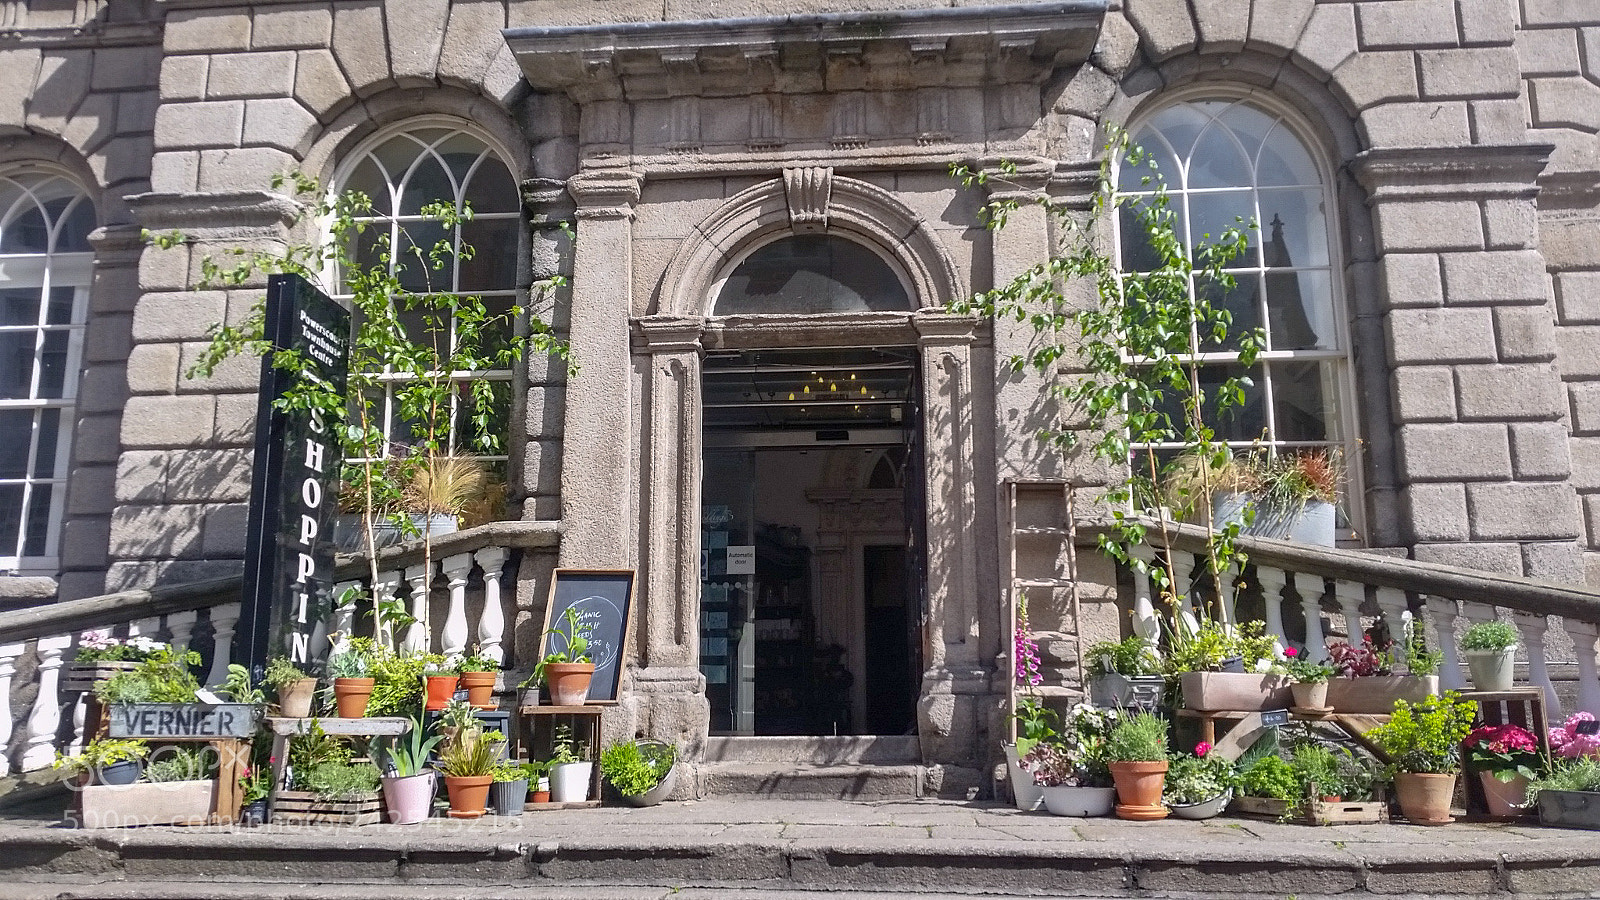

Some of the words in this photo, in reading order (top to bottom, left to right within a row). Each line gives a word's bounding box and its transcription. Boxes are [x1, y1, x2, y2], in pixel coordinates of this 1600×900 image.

[302, 324, 342, 359] Townhouse
[308, 344, 333, 367] Centre
[291, 406, 325, 664] SHOPPIN
[124, 710, 234, 736] VERNIER
